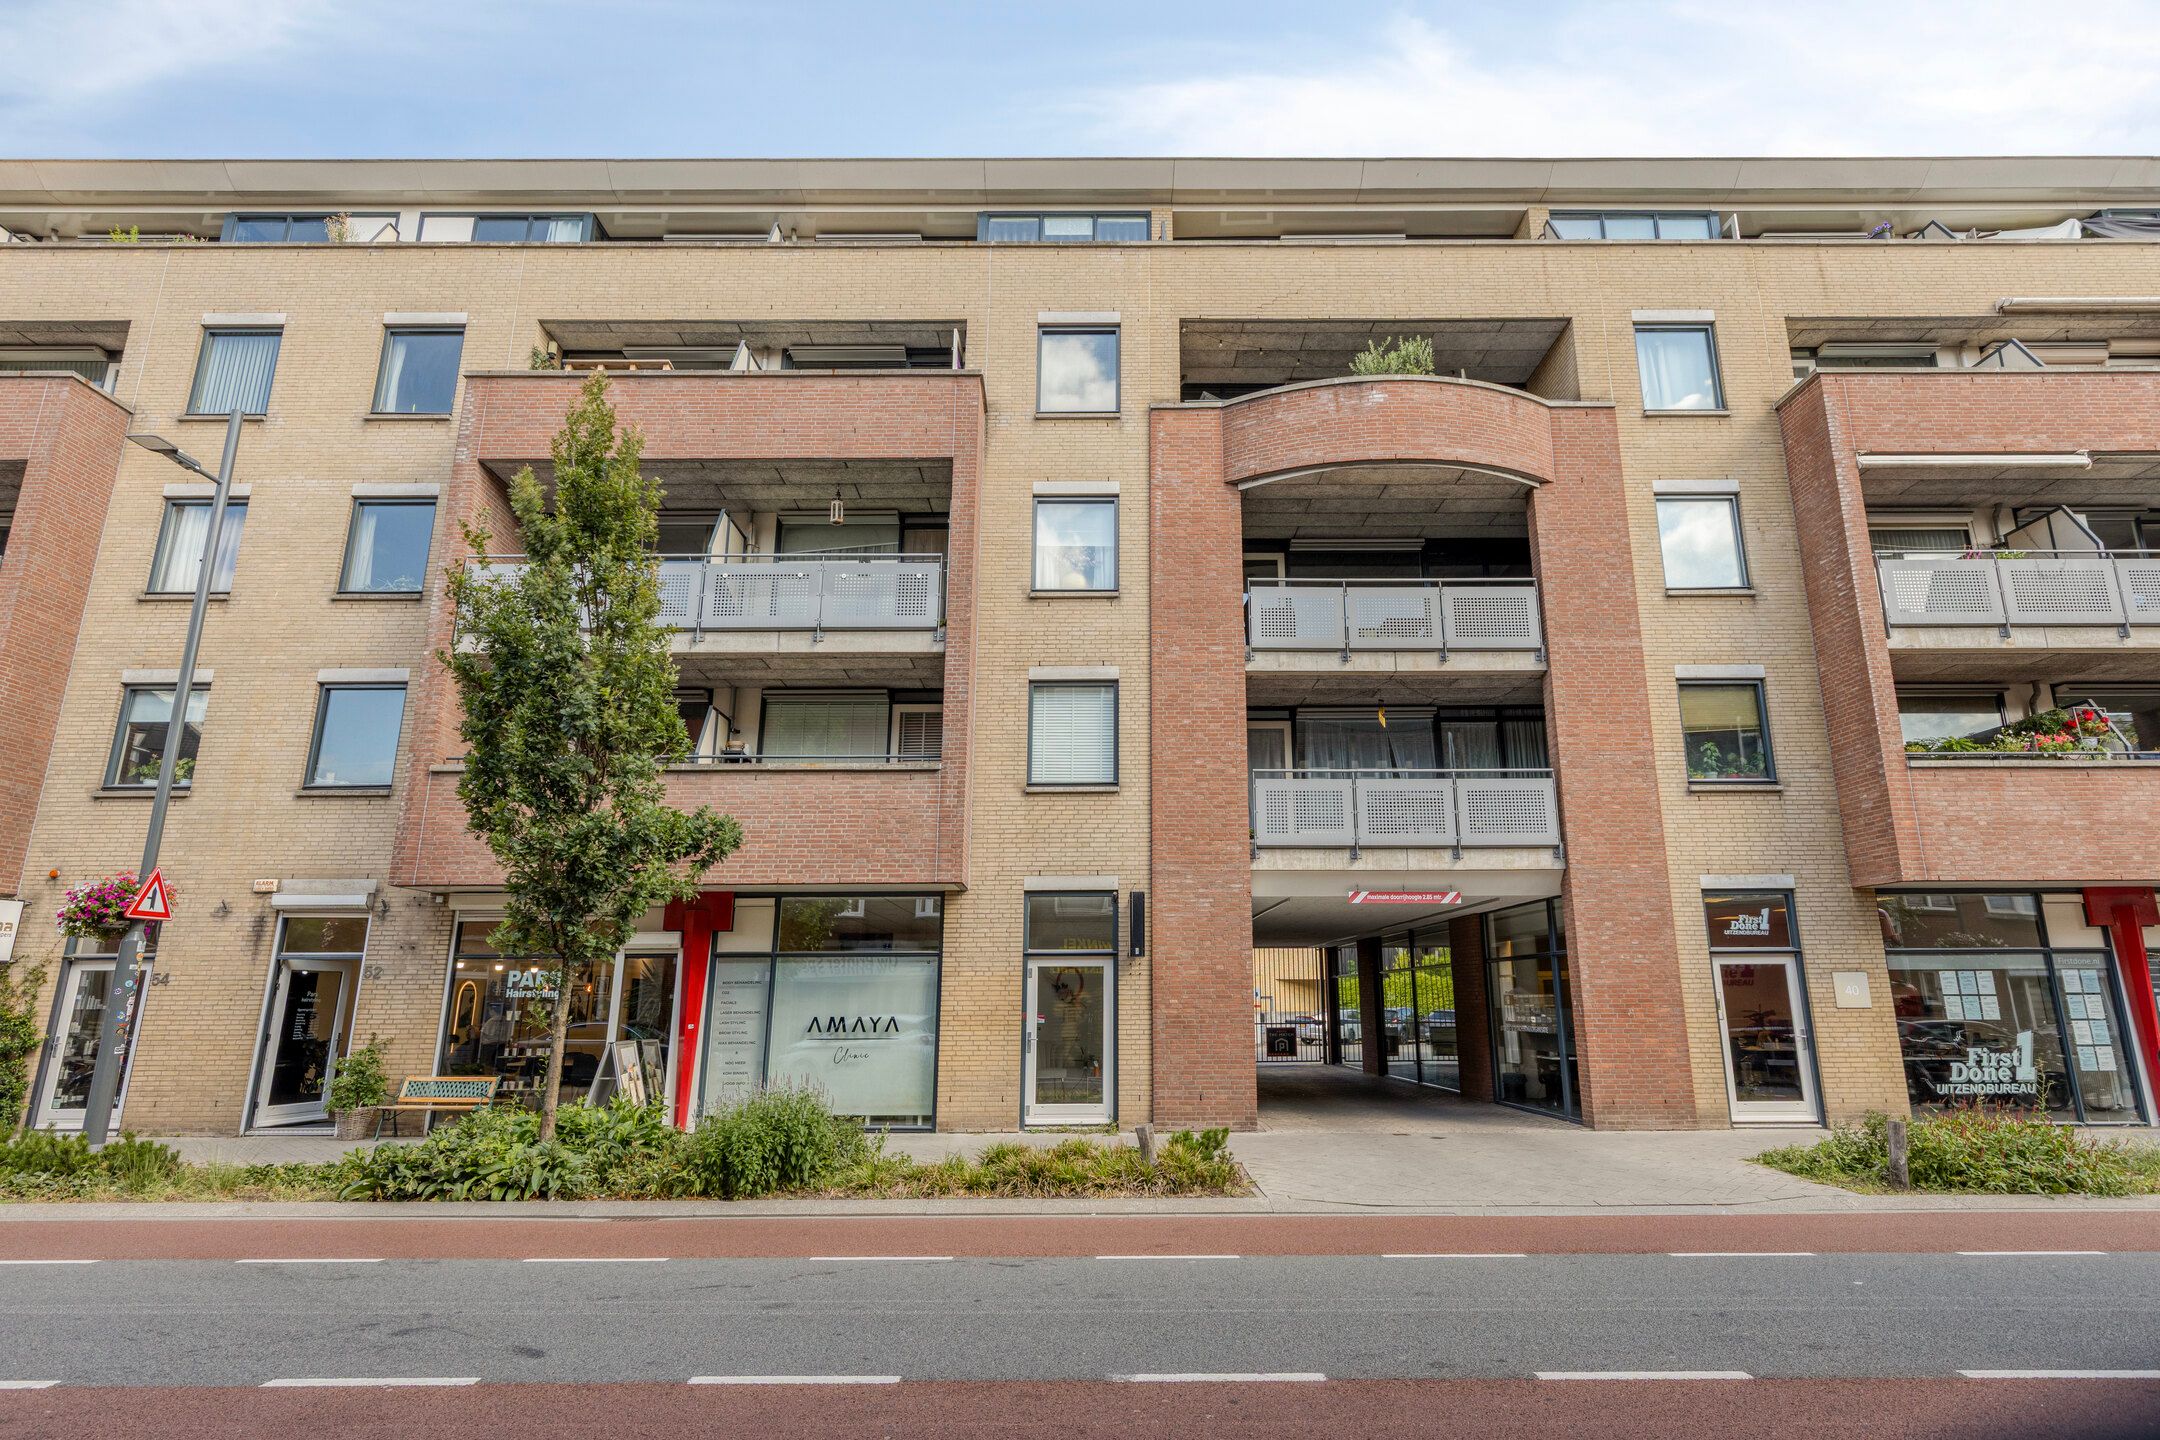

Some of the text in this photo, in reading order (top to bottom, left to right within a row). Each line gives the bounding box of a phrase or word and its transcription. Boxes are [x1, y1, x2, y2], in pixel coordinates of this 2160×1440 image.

[1390, 894, 1422, 902] doorrijhoogte
[1730, 921, 1758, 930] Done
[1738, 914, 1762, 924] First
[151, 973, 169, 986] 54
[364, 966, 383, 980] 52
[1844, 985, 1860, 996] 40
[807, 1016, 900, 1033] AMAYA
[833, 1046, 870, 1065] Clinic
[1966, 1047, 2020, 1068] First
[2016, 1030, 2037, 1081] 1
[1950, 1062, 2013, 1083] Done
[1936, 1083, 2036, 1095] UITZENDBUREAU
